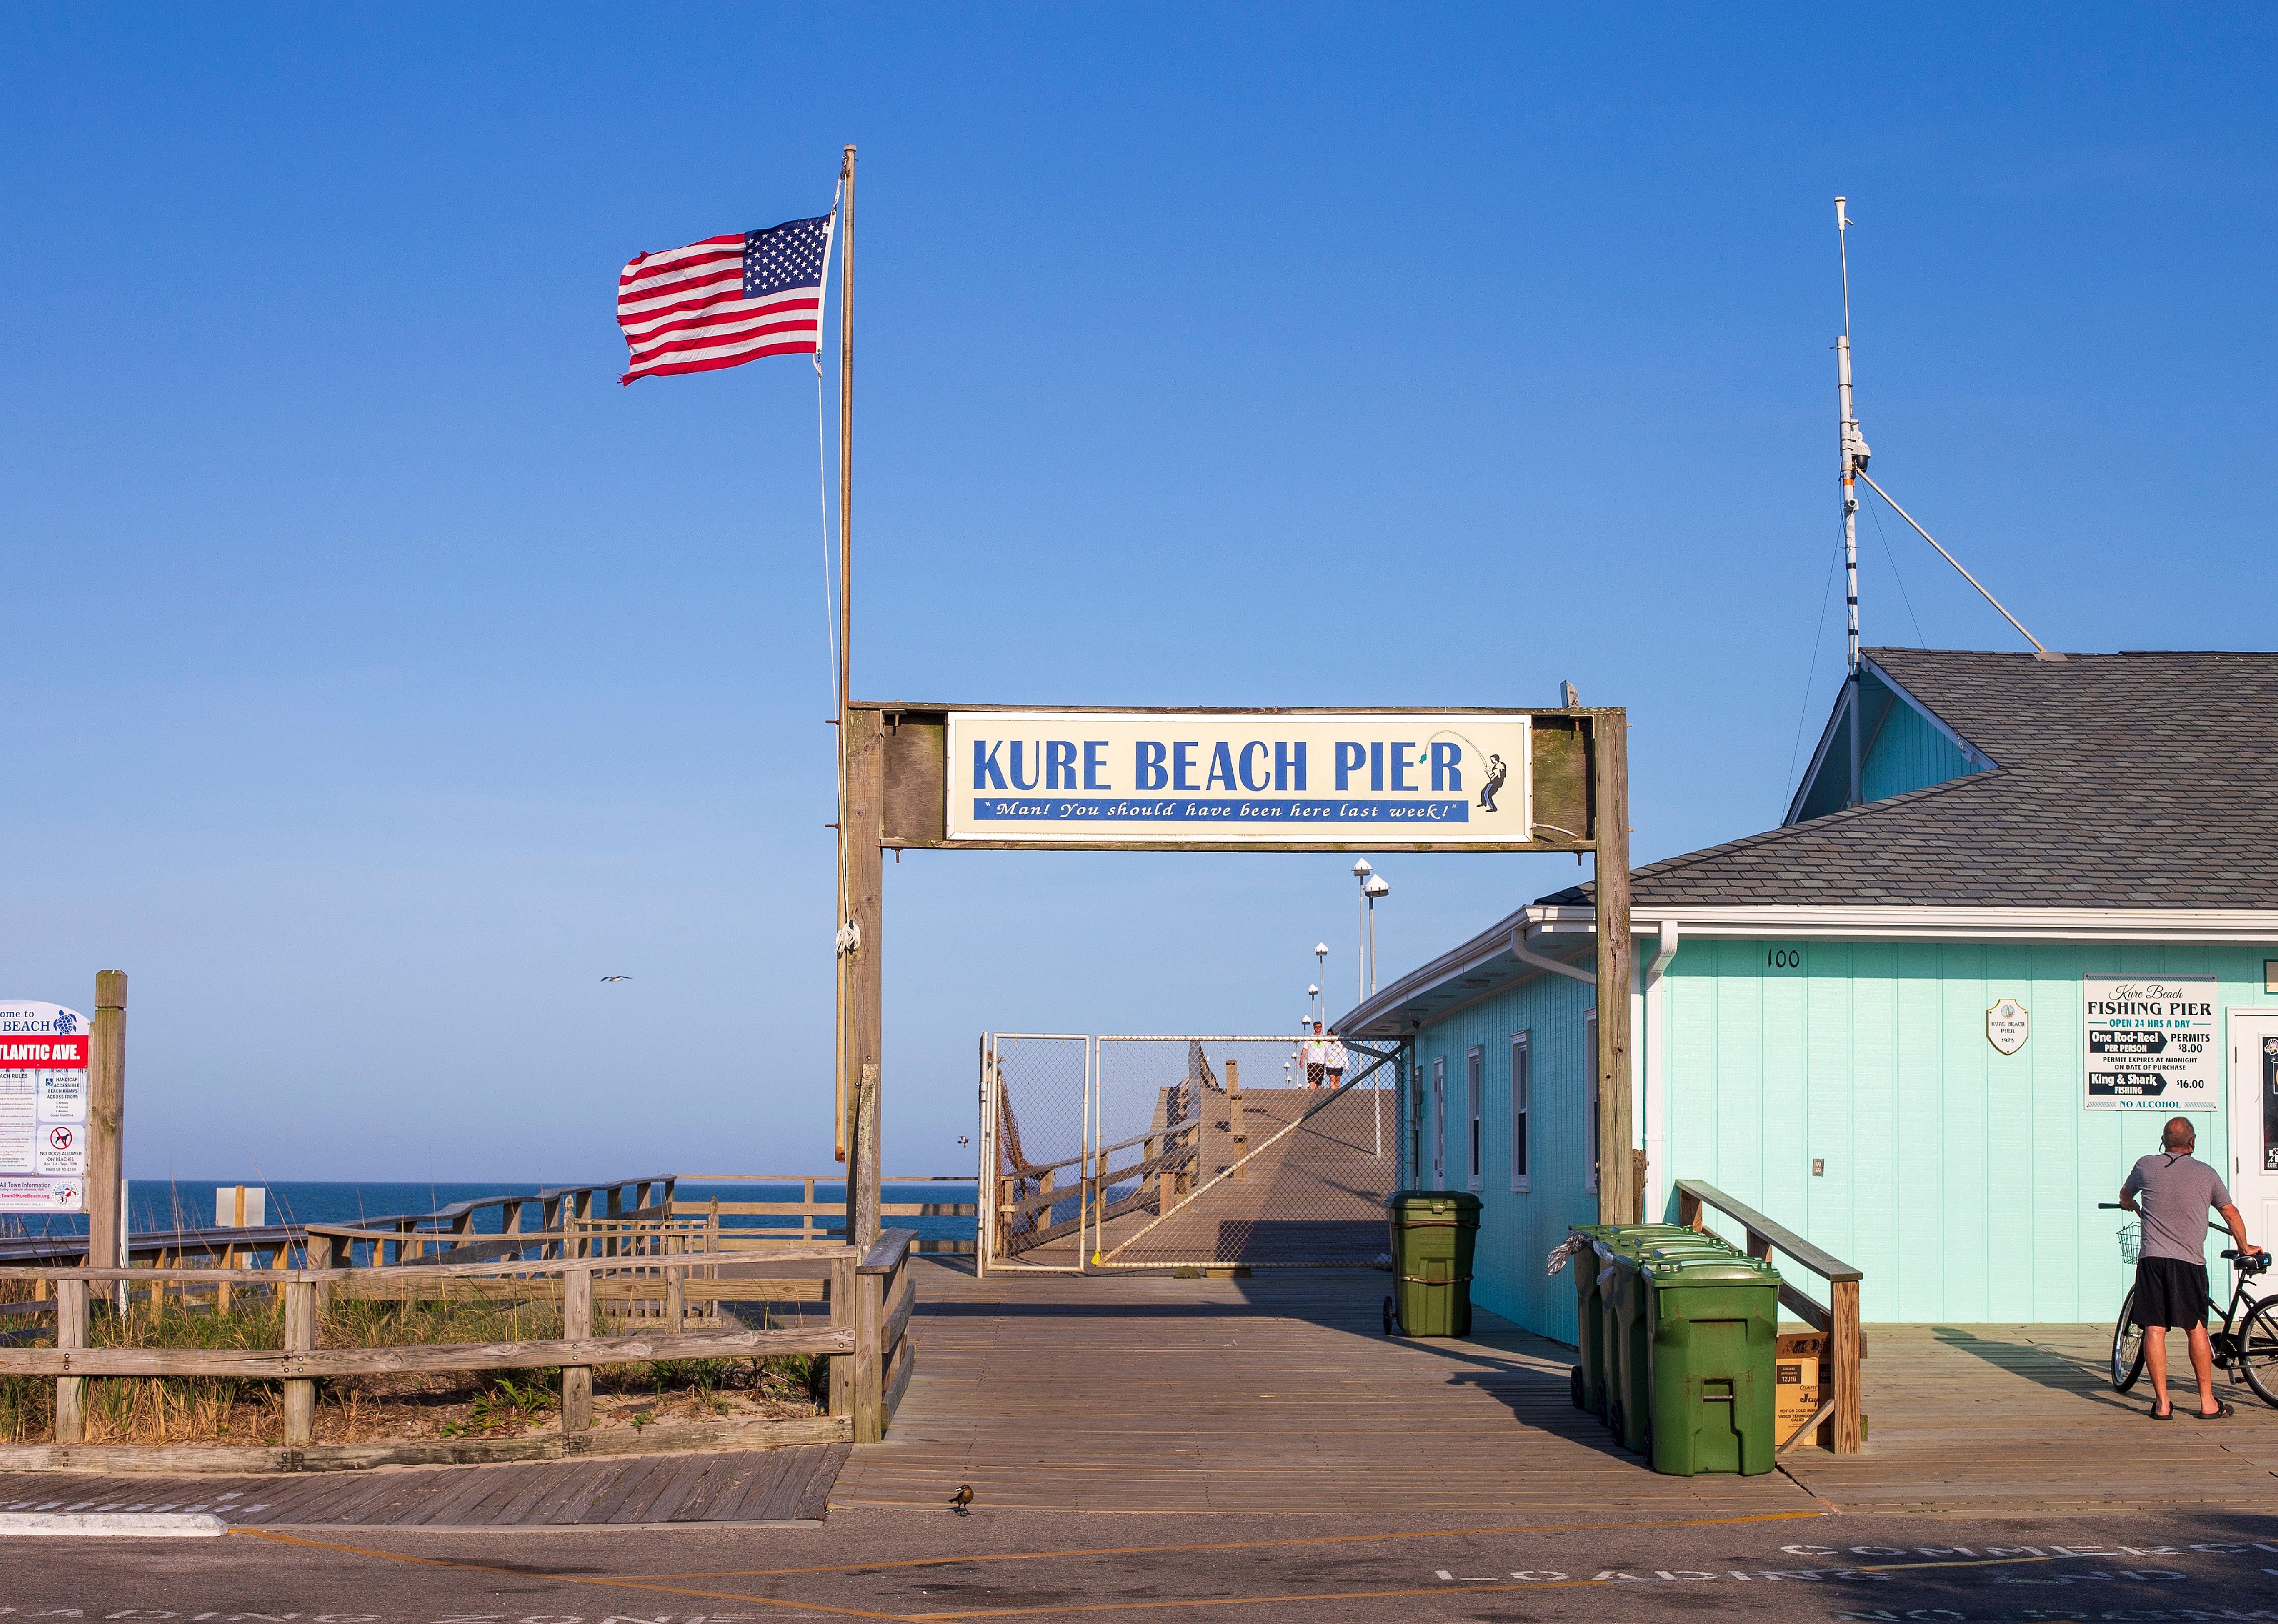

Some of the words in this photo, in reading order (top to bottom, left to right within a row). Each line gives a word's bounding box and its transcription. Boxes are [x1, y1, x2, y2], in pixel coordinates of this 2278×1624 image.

[973, 740, 1111, 790] KURE
[1135, 740, 1307, 791] BEACH
[1335, 742, 1463, 791] PIER
[1059, 803, 1099, 818] You
[1107, 802, 1176, 816] should
[1185, 802, 1231, 816] have
[1240, 803, 1282, 817] been
[1290, 803, 1331, 817] here
[1339, 803, 1379, 817] last
[1767, 949, 1799, 968] 100
[2108, 984, 2143, 1001] Kure
[2145, 984, 2183, 999] Beach
[2088, 1002, 2162, 1015] FISHING
[2170, 1002, 2212, 1015] PIER
[3, 1021, 50, 1031] BEACH
[2109, 1019, 2132, 1027] OPEN
[2135, 1019, 2145, 1027] 24
[2148, 1019, 2164, 1028] HRS
[2174, 1019, 2190, 1028] DAY
[2092, 1031, 2112, 1043] One
[2114, 1031, 2159, 1043] Rod-Reel
[2171, 1034, 2210, 1043] PERMITS
[52, 1044, 80, 1060] AVE.
[2105, 1044, 2119, 1052] PER
[2120, 1044, 2147, 1052] PERSON
[2178, 1044, 2203, 1053] $8.00
[2091, 1074, 2115, 1086] King
[2116, 1074, 2126, 1085] &
[2128, 1074, 2158, 1086] Shark
[2177, 1079, 2204, 1088] $16.00
[1434, 1570, 1896, 1581] LOADING
[429, 1614, 755, 1624] ZONE
